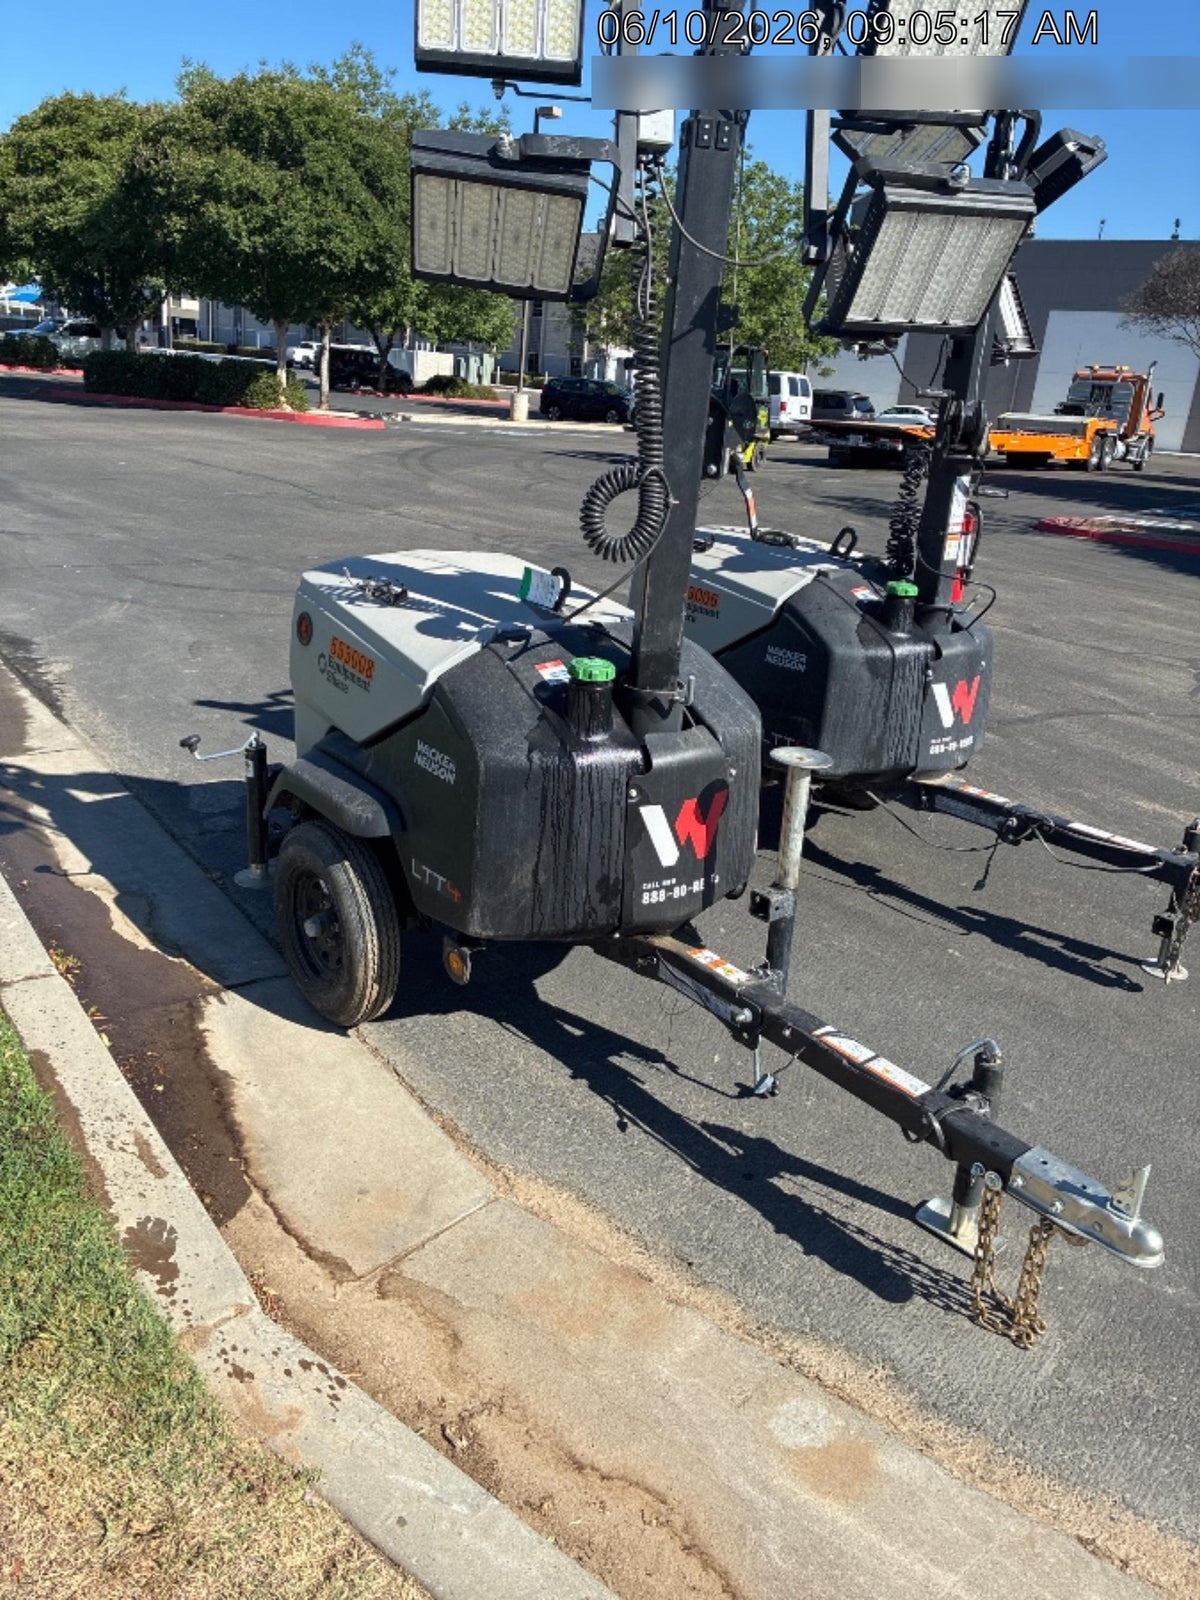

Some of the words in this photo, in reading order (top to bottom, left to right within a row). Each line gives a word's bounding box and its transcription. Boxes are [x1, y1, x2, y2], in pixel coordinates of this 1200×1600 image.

[413, 751, 456, 785] NEUSON
[416, 738, 456, 772] WACKER
[411, 857, 462, 902] LTT4
[641, 874, 720, 905] 888-80-RETS
[642, 881, 660, 890] CALL
